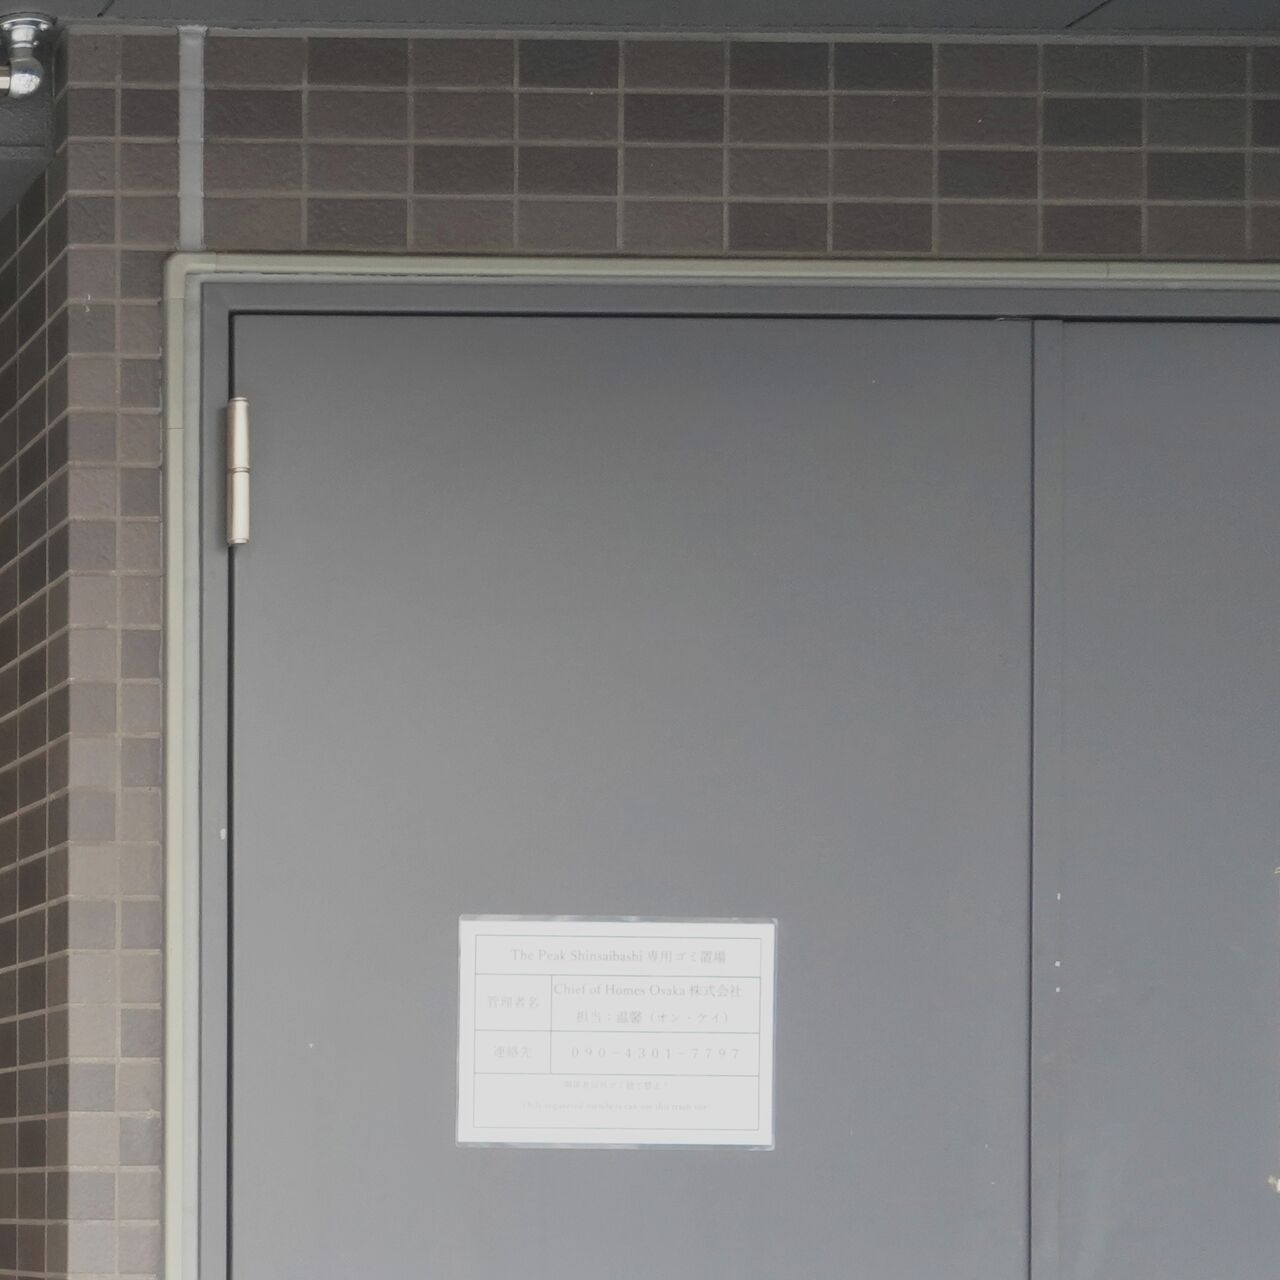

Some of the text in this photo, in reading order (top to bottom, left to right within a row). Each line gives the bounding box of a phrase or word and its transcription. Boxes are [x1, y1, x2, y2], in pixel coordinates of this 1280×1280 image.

[511, 948, 535, 961] The
[538, 948, 567, 961] Peak
[570, 949, 643, 963] Shinsaibashi
[553, 983, 743, 998] Chief of Homes Osaka 株式会社
